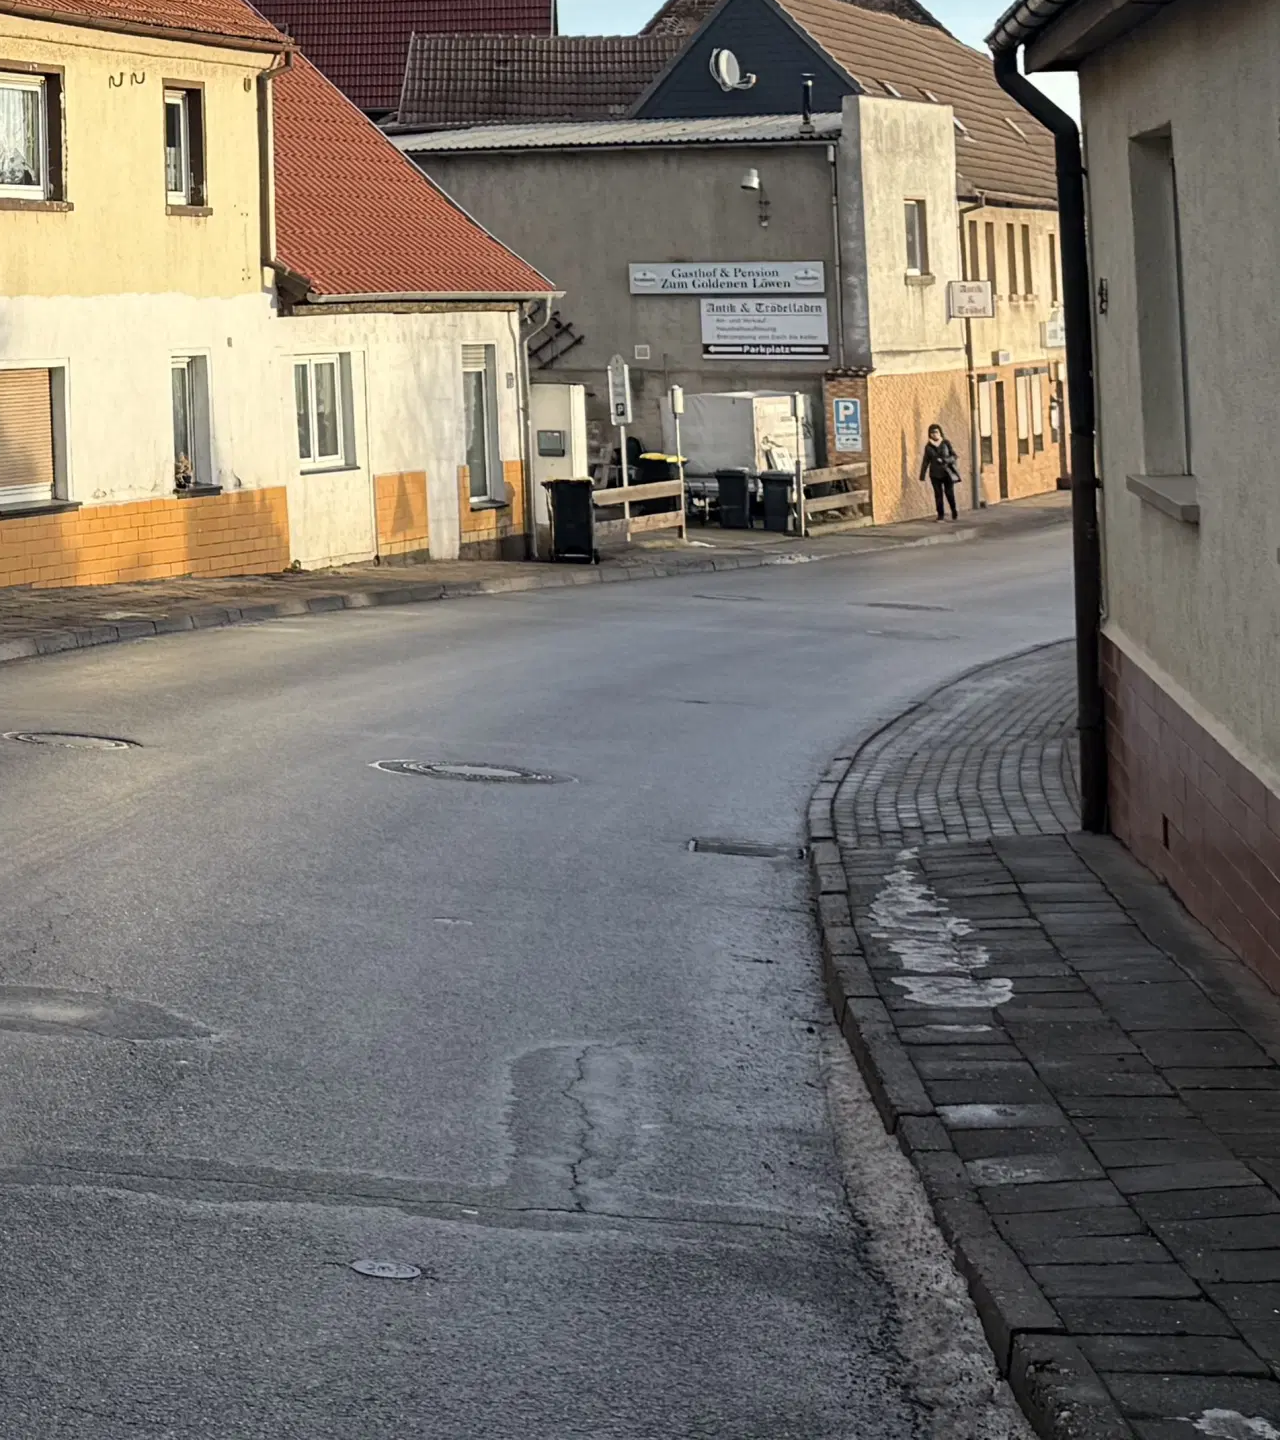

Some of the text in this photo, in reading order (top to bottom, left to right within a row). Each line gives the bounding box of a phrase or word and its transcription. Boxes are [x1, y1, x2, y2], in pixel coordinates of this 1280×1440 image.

[671, 266, 779, 279] Gasthof & Pension
[660, 278, 688, 289] Zum
[691, 277, 748, 289] Goldenen
[752, 277, 791, 289] Löwen
[706, 302, 737, 313] Antik
[740, 302, 750, 313] &
[743, 345, 791, 355] Parkplatz
[838, 401, 854, 421] P
